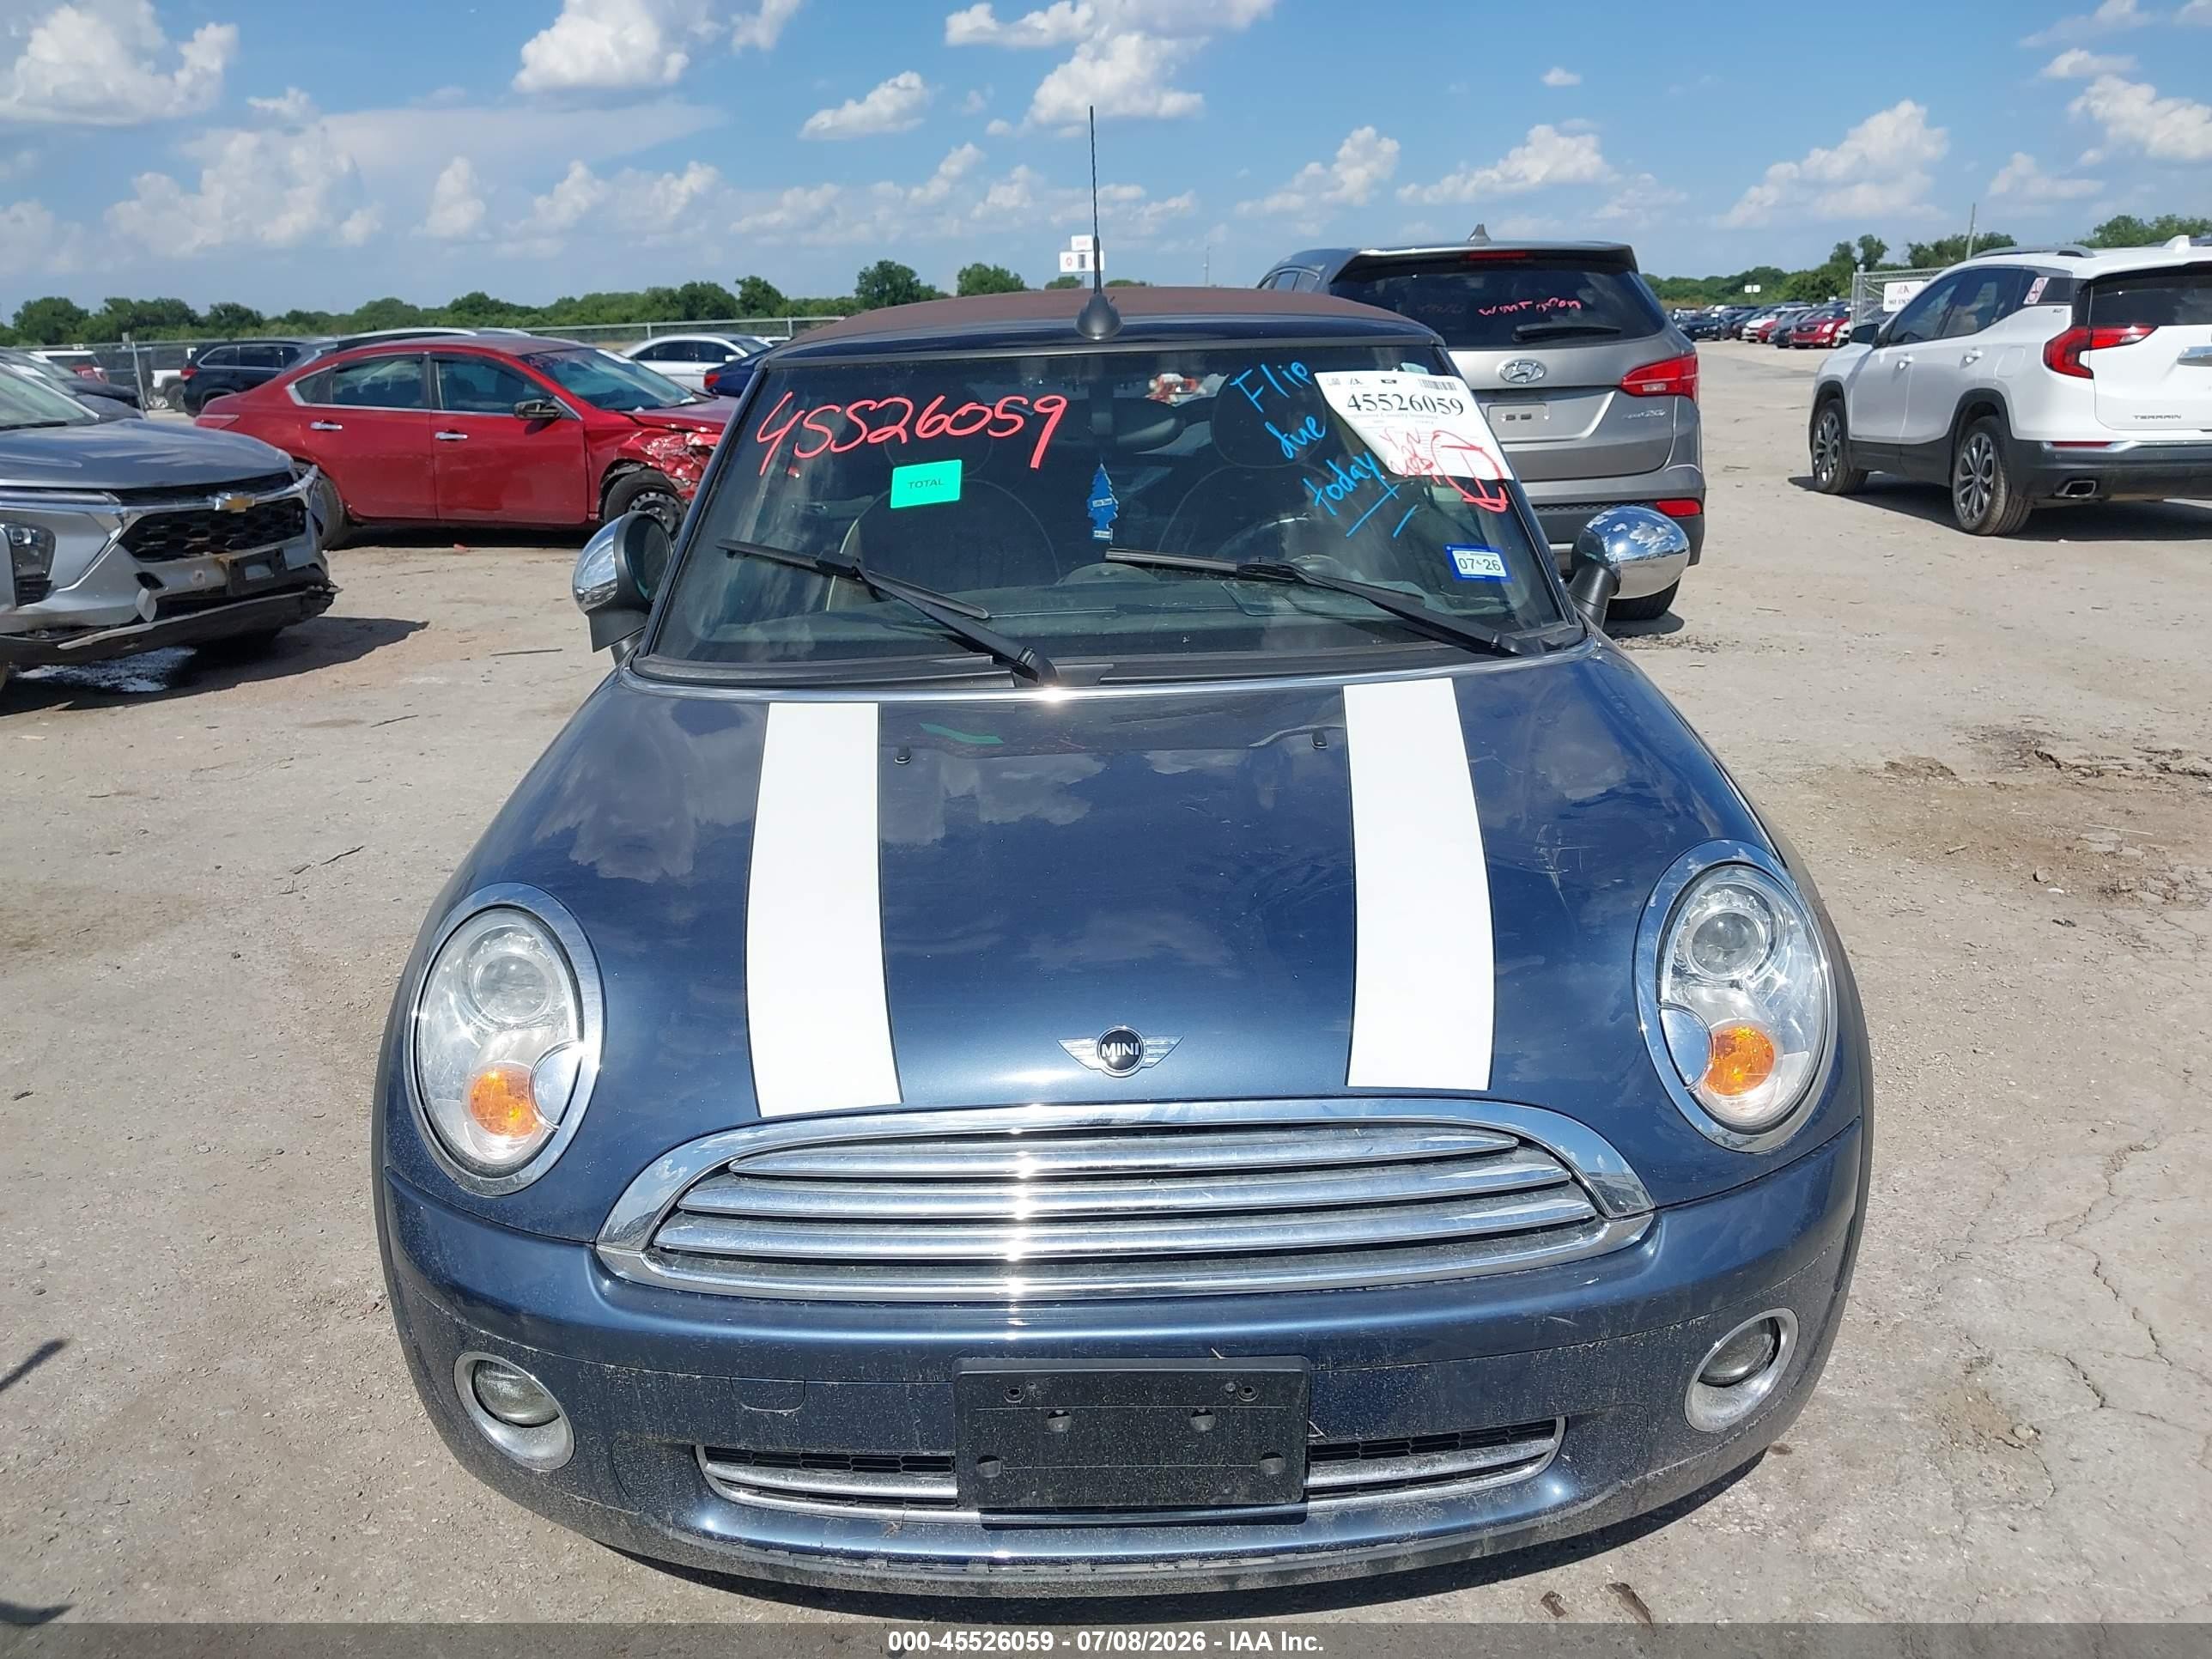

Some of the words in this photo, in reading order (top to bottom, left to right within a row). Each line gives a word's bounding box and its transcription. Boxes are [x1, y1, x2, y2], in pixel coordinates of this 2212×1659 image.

[1230, 362, 1313, 413] Flip
[1346, 393, 1464, 416] 45526059
[756, 391, 1068, 477] 45526059
[1265, 416, 1326, 459] due
[907, 477, 945, 489] TOTAL
[1303, 452, 1400, 516] today
[1458, 557, 1475, 570] 07
[1482, 558, 1501, 571] 26
[1101, 1042, 1140, 1058] MINI
